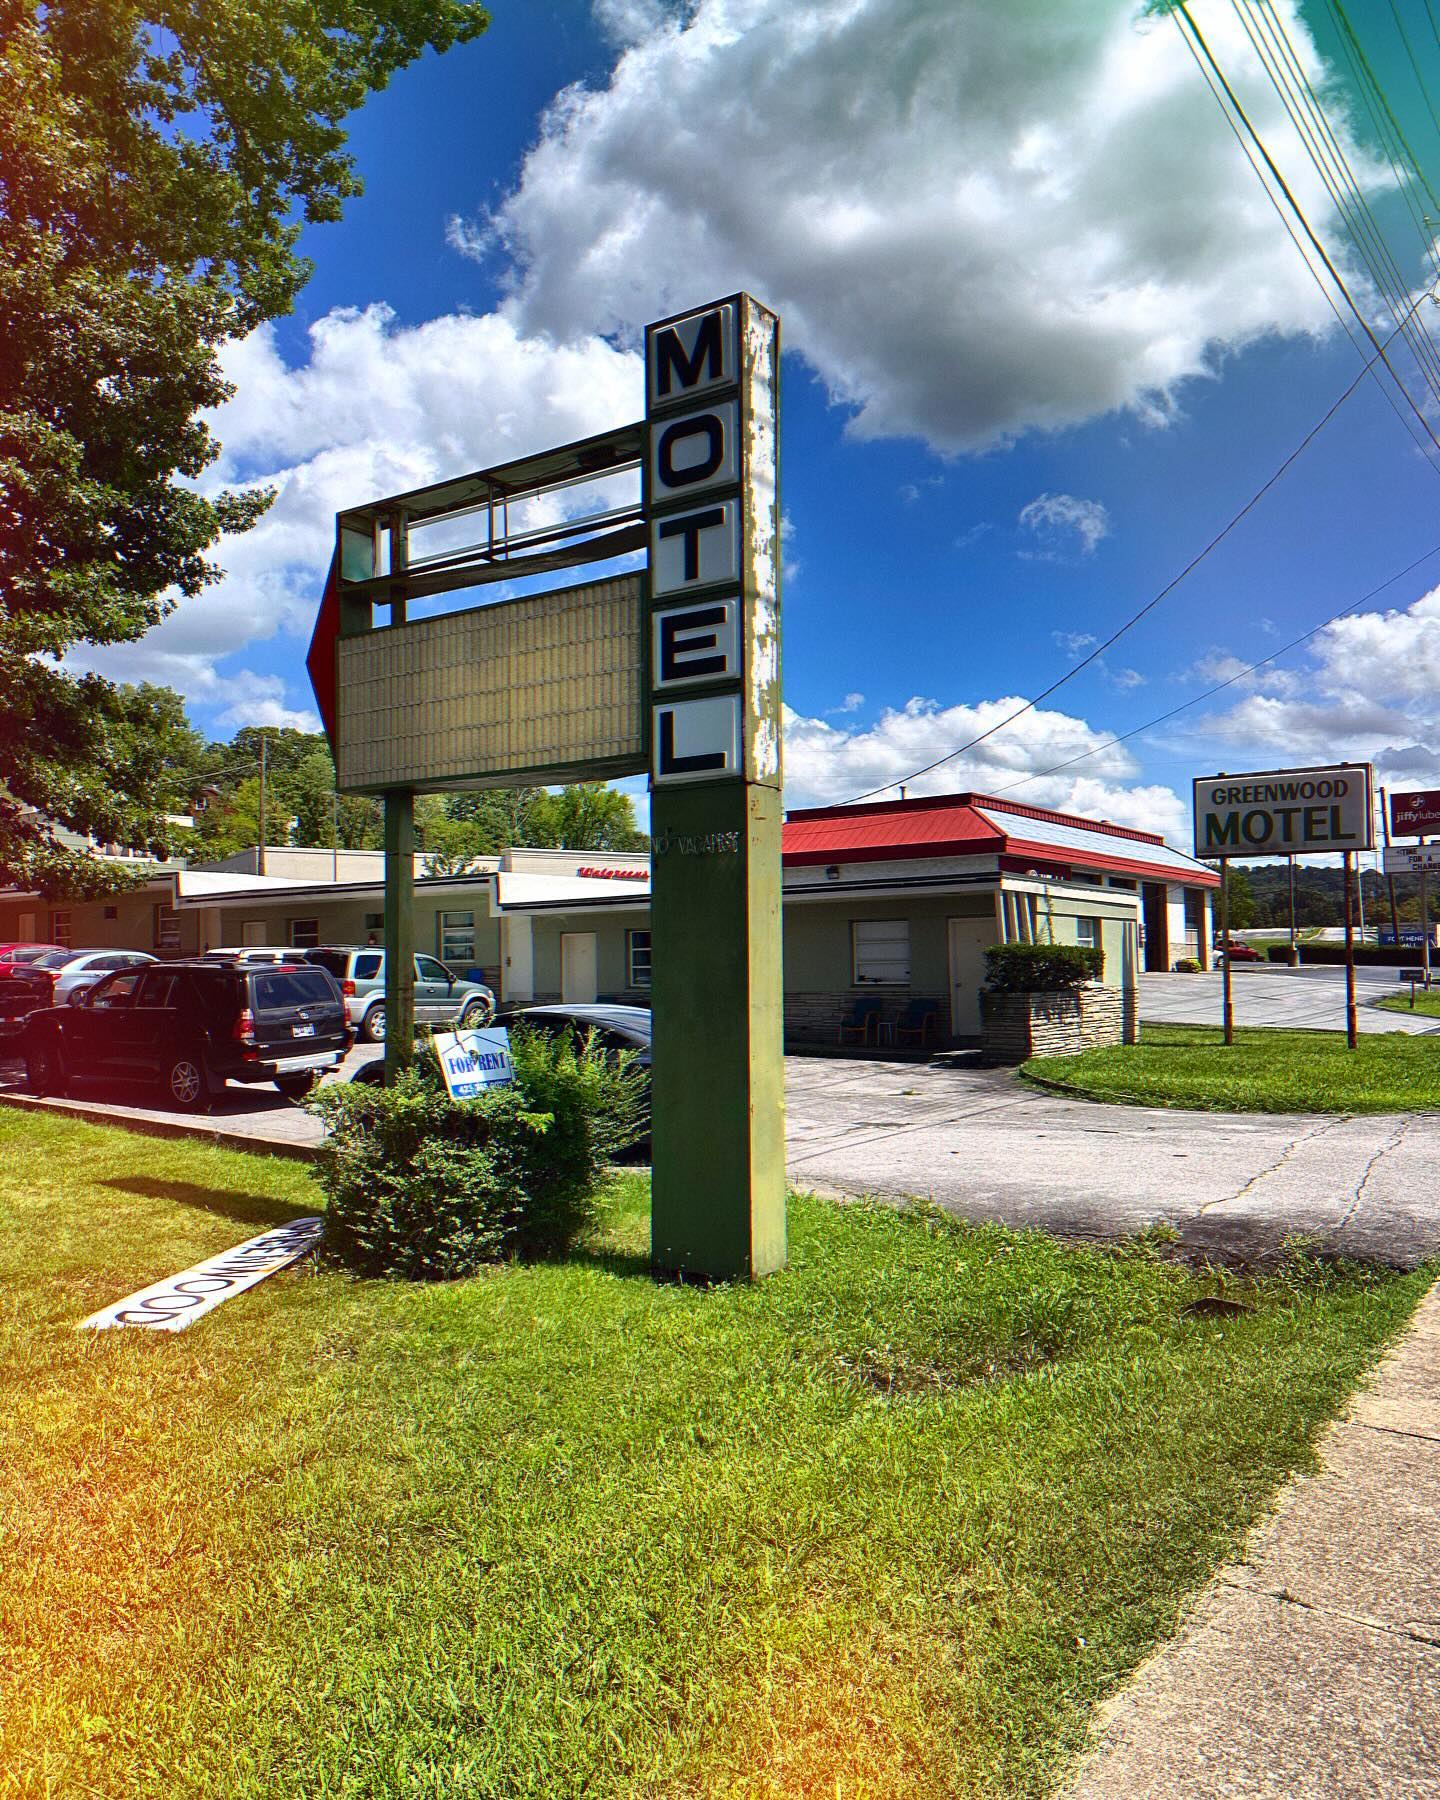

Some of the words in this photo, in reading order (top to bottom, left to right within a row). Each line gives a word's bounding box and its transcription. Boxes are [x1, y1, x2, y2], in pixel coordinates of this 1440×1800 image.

[657, 310, 727, 776] MOTEL
[1211, 779, 1349, 806] GREENWOOD
[1205, 805, 1357, 848] MOTEL
[478, 1051, 506, 1071] RENT
